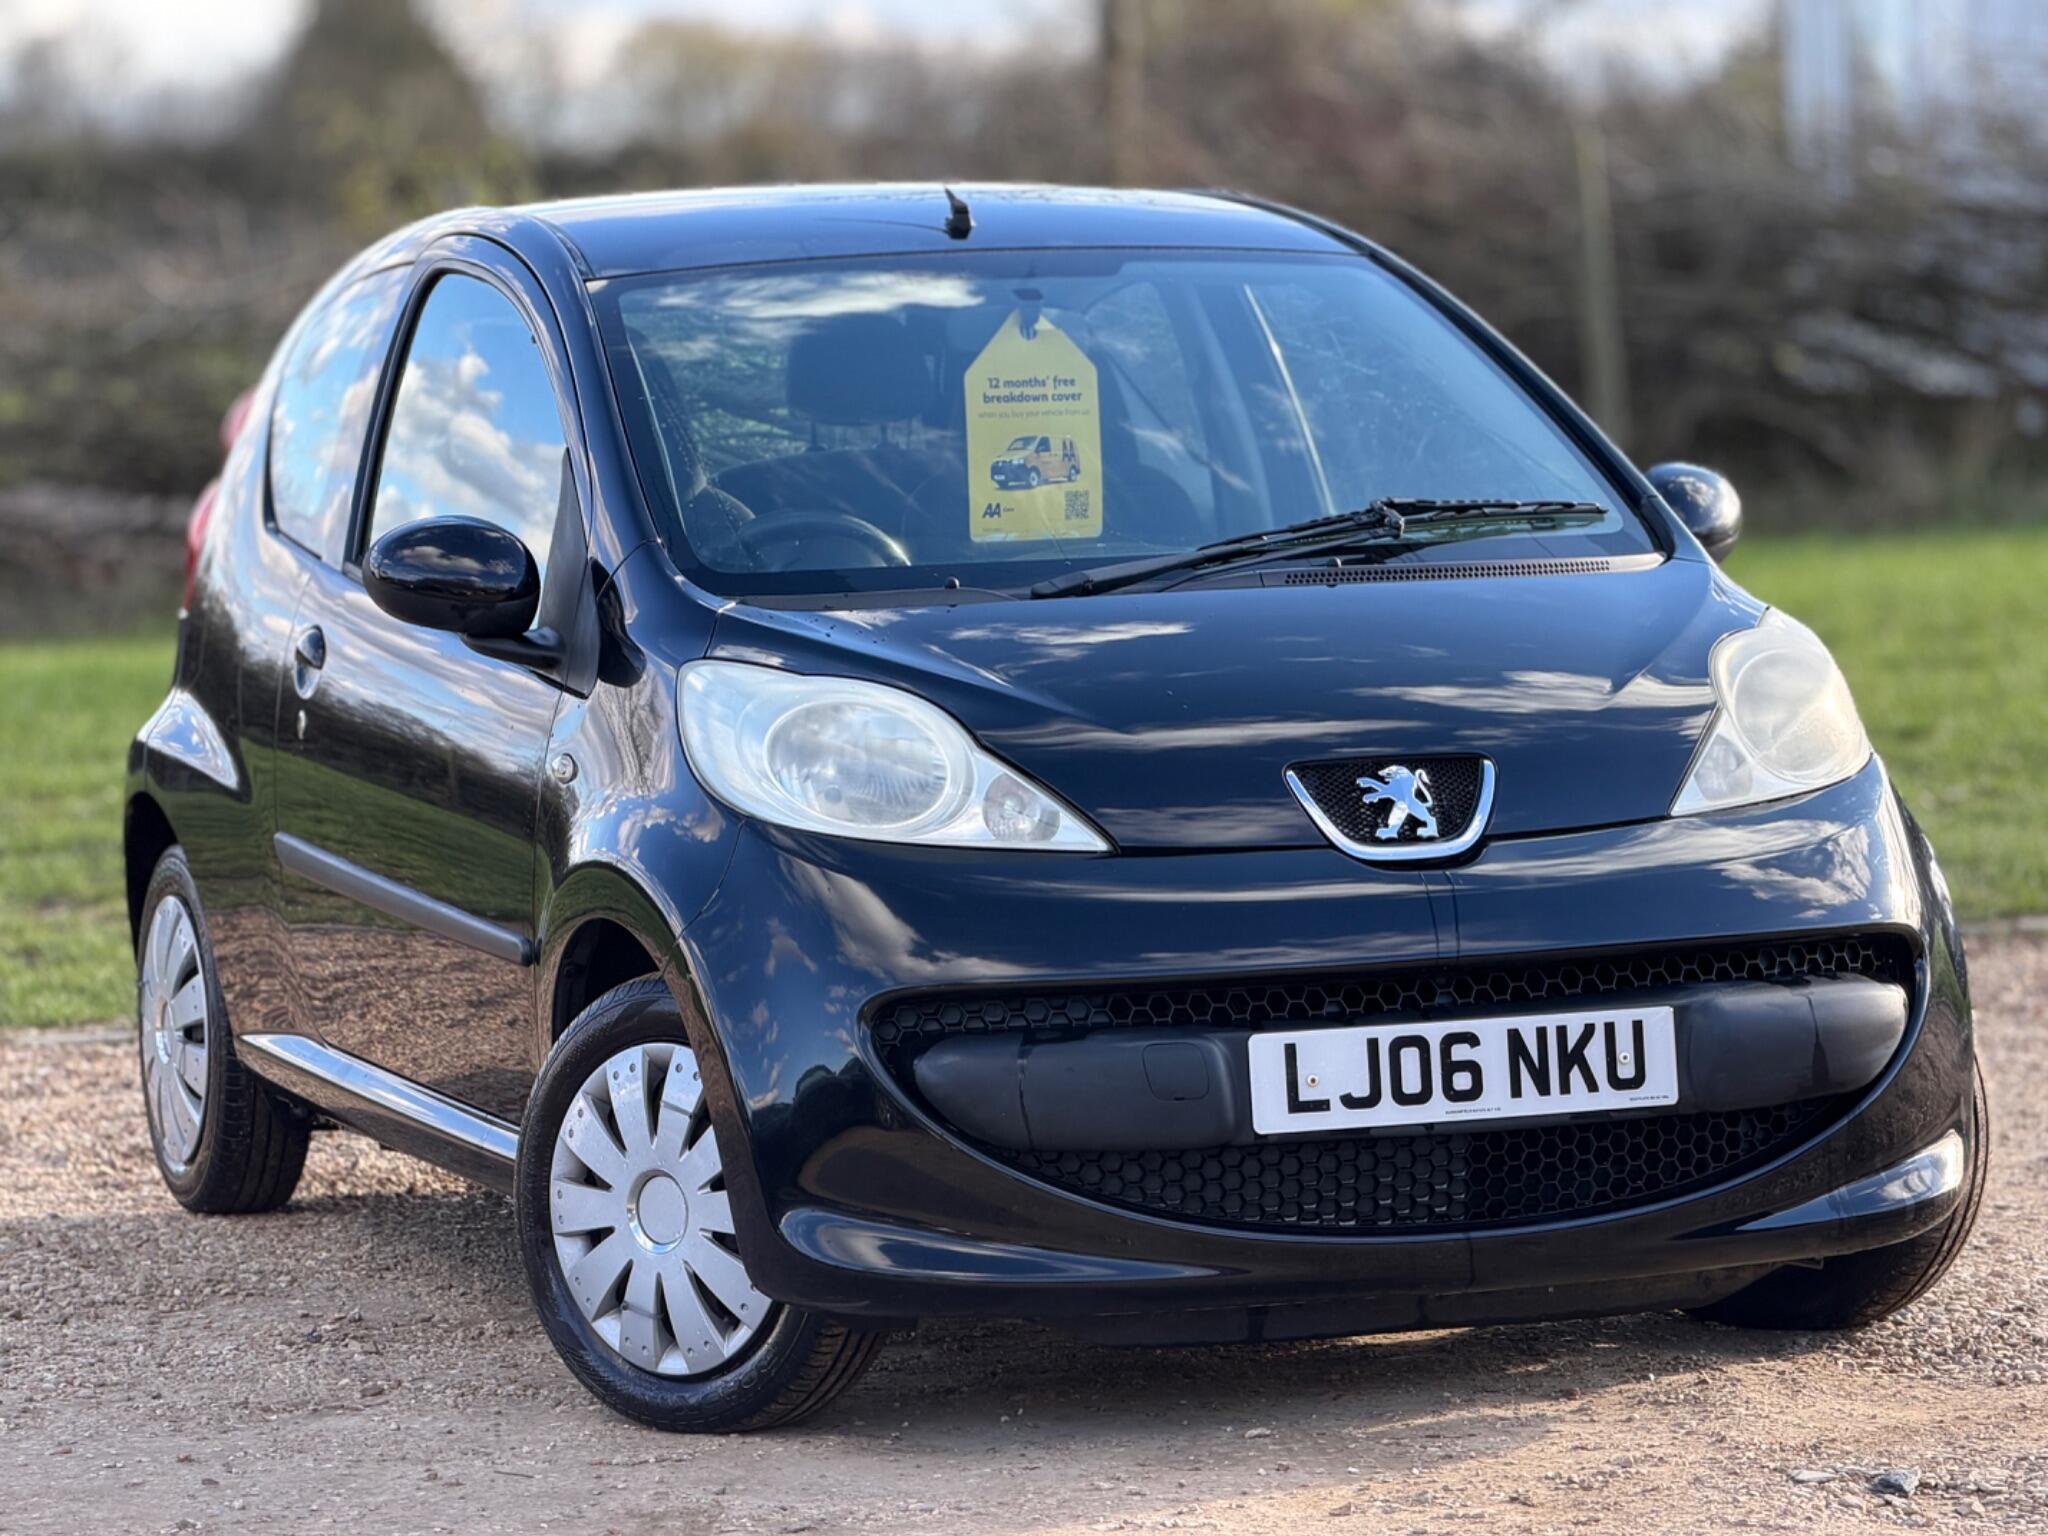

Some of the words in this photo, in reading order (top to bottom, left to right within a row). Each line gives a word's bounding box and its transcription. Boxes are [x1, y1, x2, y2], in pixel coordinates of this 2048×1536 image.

[987, 377, 1000, 389] 12
[1003, 376, 1049, 388] months'
[1053, 376, 1076, 390] free
[983, 391, 1049, 404] breakdown
[1051, 393, 1082, 402] cover
[982, 502, 1001, 518] AA
[1284, 1031, 1484, 1114] LJ06
[1507, 1019, 1647, 1099] NKU
